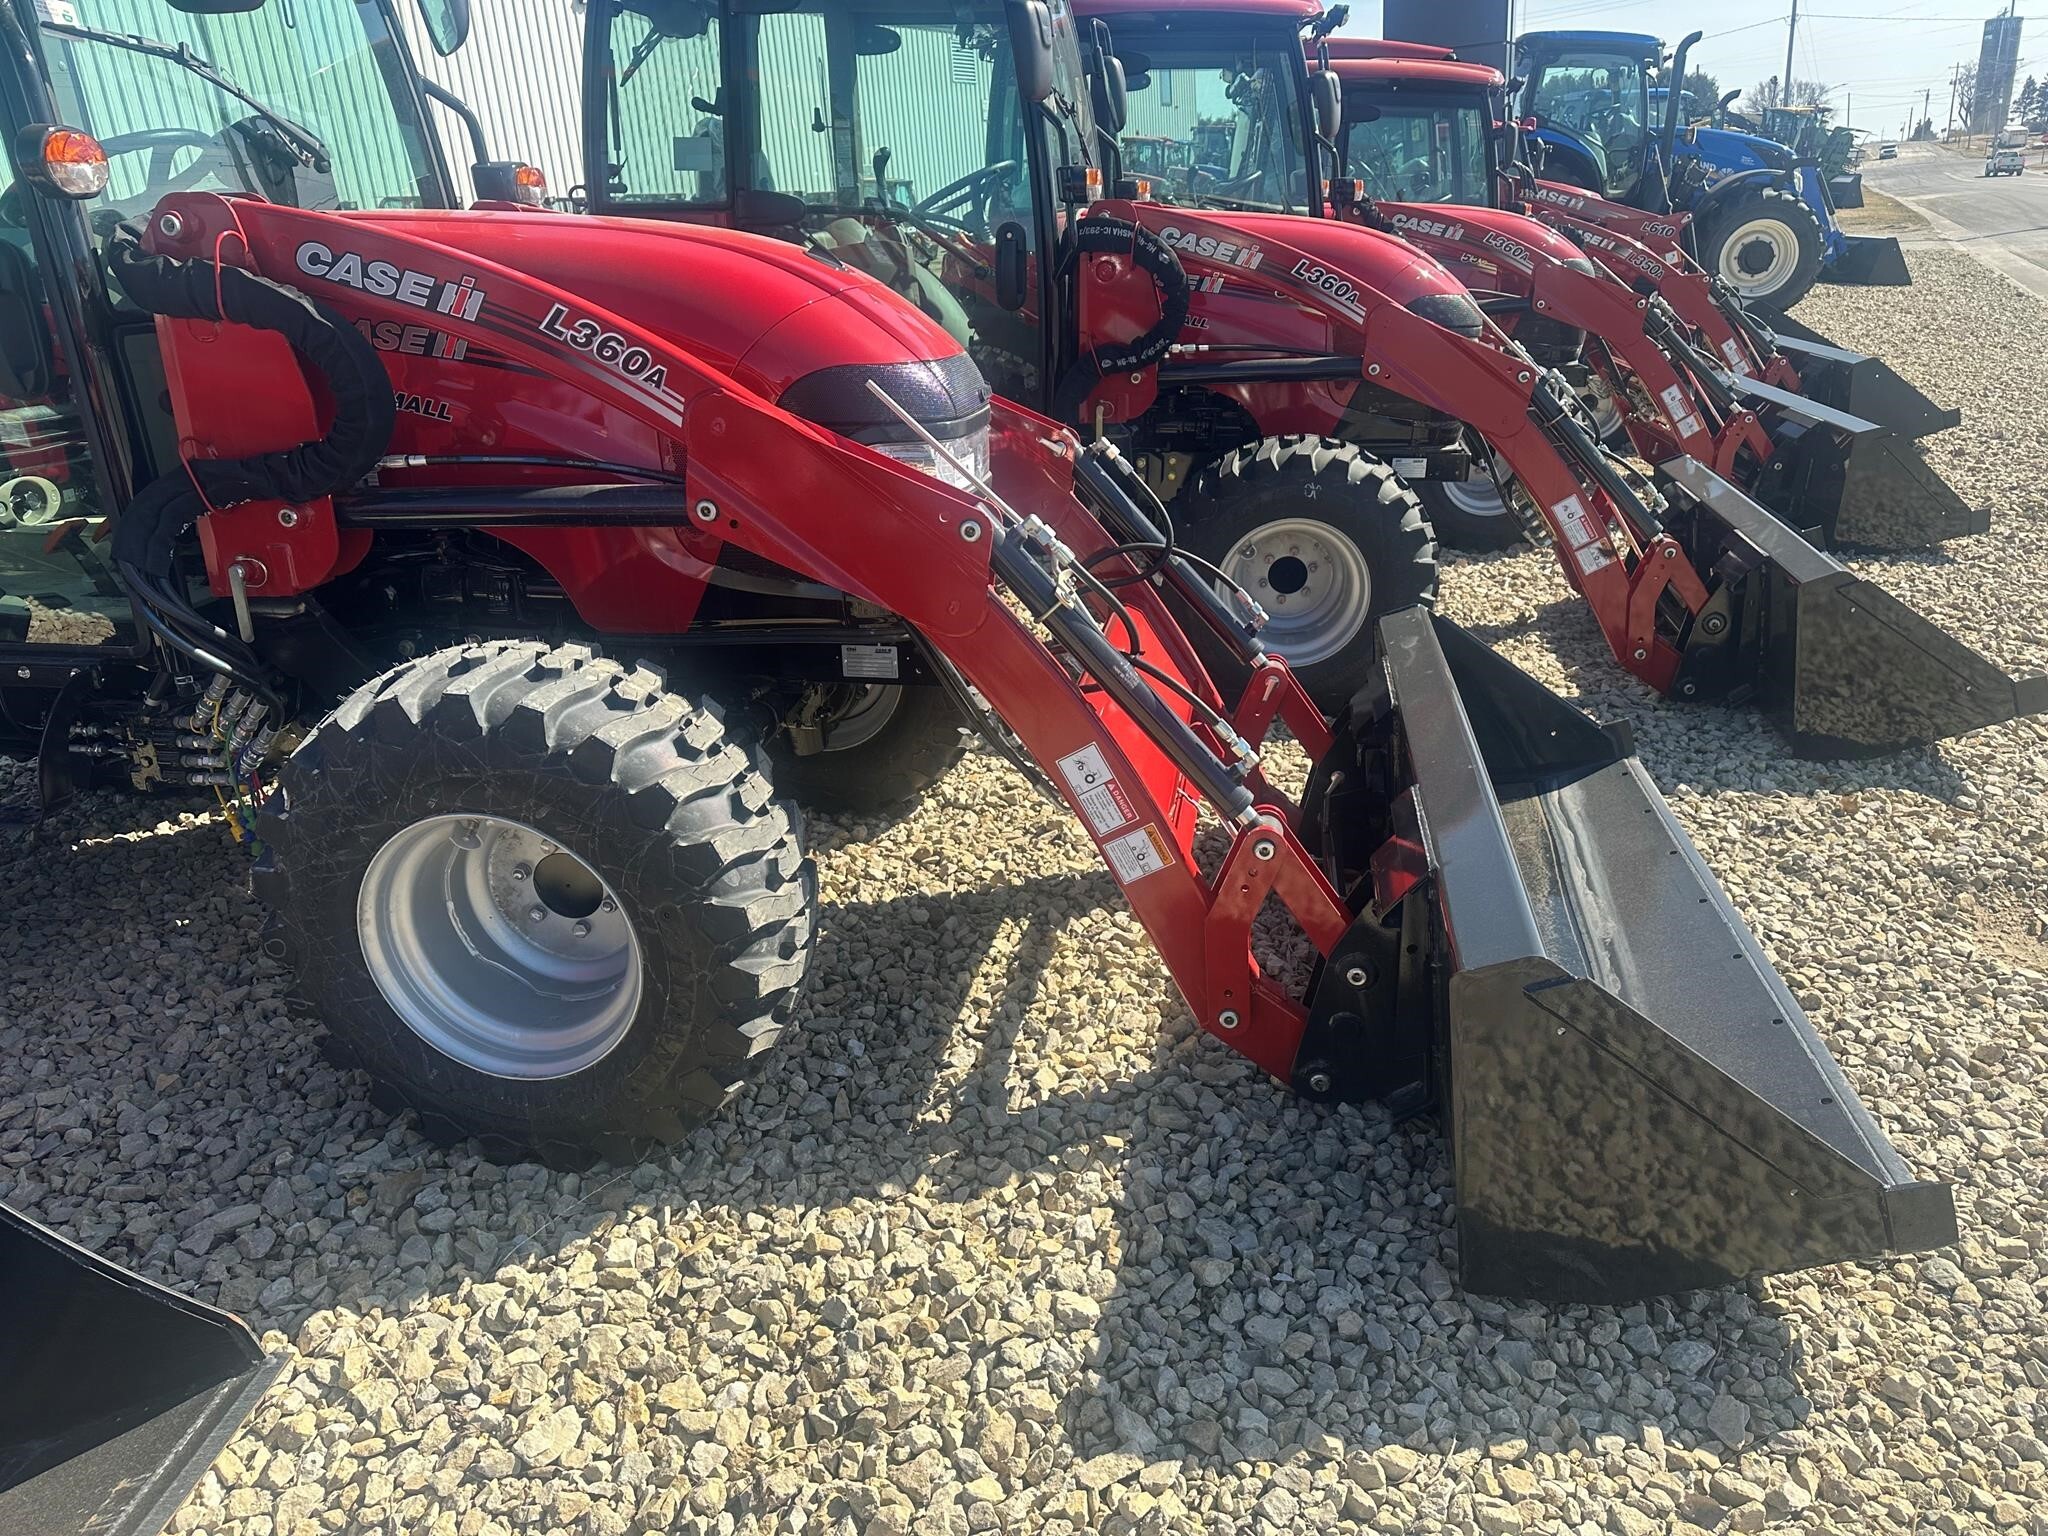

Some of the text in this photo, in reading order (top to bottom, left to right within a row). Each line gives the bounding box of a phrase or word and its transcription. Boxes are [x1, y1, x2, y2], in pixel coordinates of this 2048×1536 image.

[1536, 188, 1569, 206] ASE
[1391, 213, 1446, 236] CASE
[1640, 220, 1675, 238] L610
[1159, 226, 1237, 263] CASE
[1483, 231, 1530, 264] L360A
[296, 241, 435, 307] CASE
[1291, 258, 1360, 305] L360A
[353, 319, 430, 355] ASE
[538, 302, 668, 393] L360A
[1112, 790, 1134, 820] DANGER
